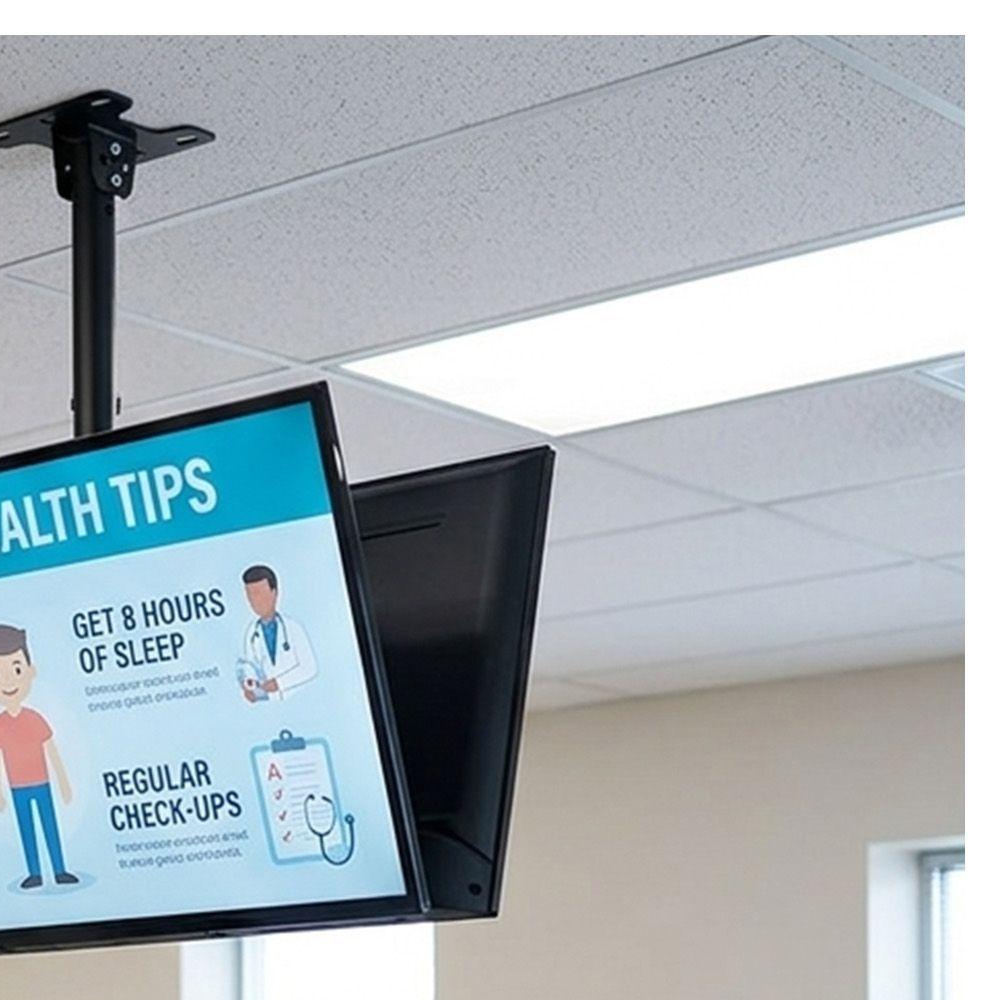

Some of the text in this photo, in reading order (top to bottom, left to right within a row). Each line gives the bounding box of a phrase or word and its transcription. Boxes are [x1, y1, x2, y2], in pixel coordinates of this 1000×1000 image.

[108, 457, 218, 529] TIPS
[72, 588, 225, 639] GET 8 HOURS
[79, 632, 185, 674] OF SLEEP
[102, 759, 212, 797] REGULAR
[110, 790, 243, 831] CHECK-UPS
